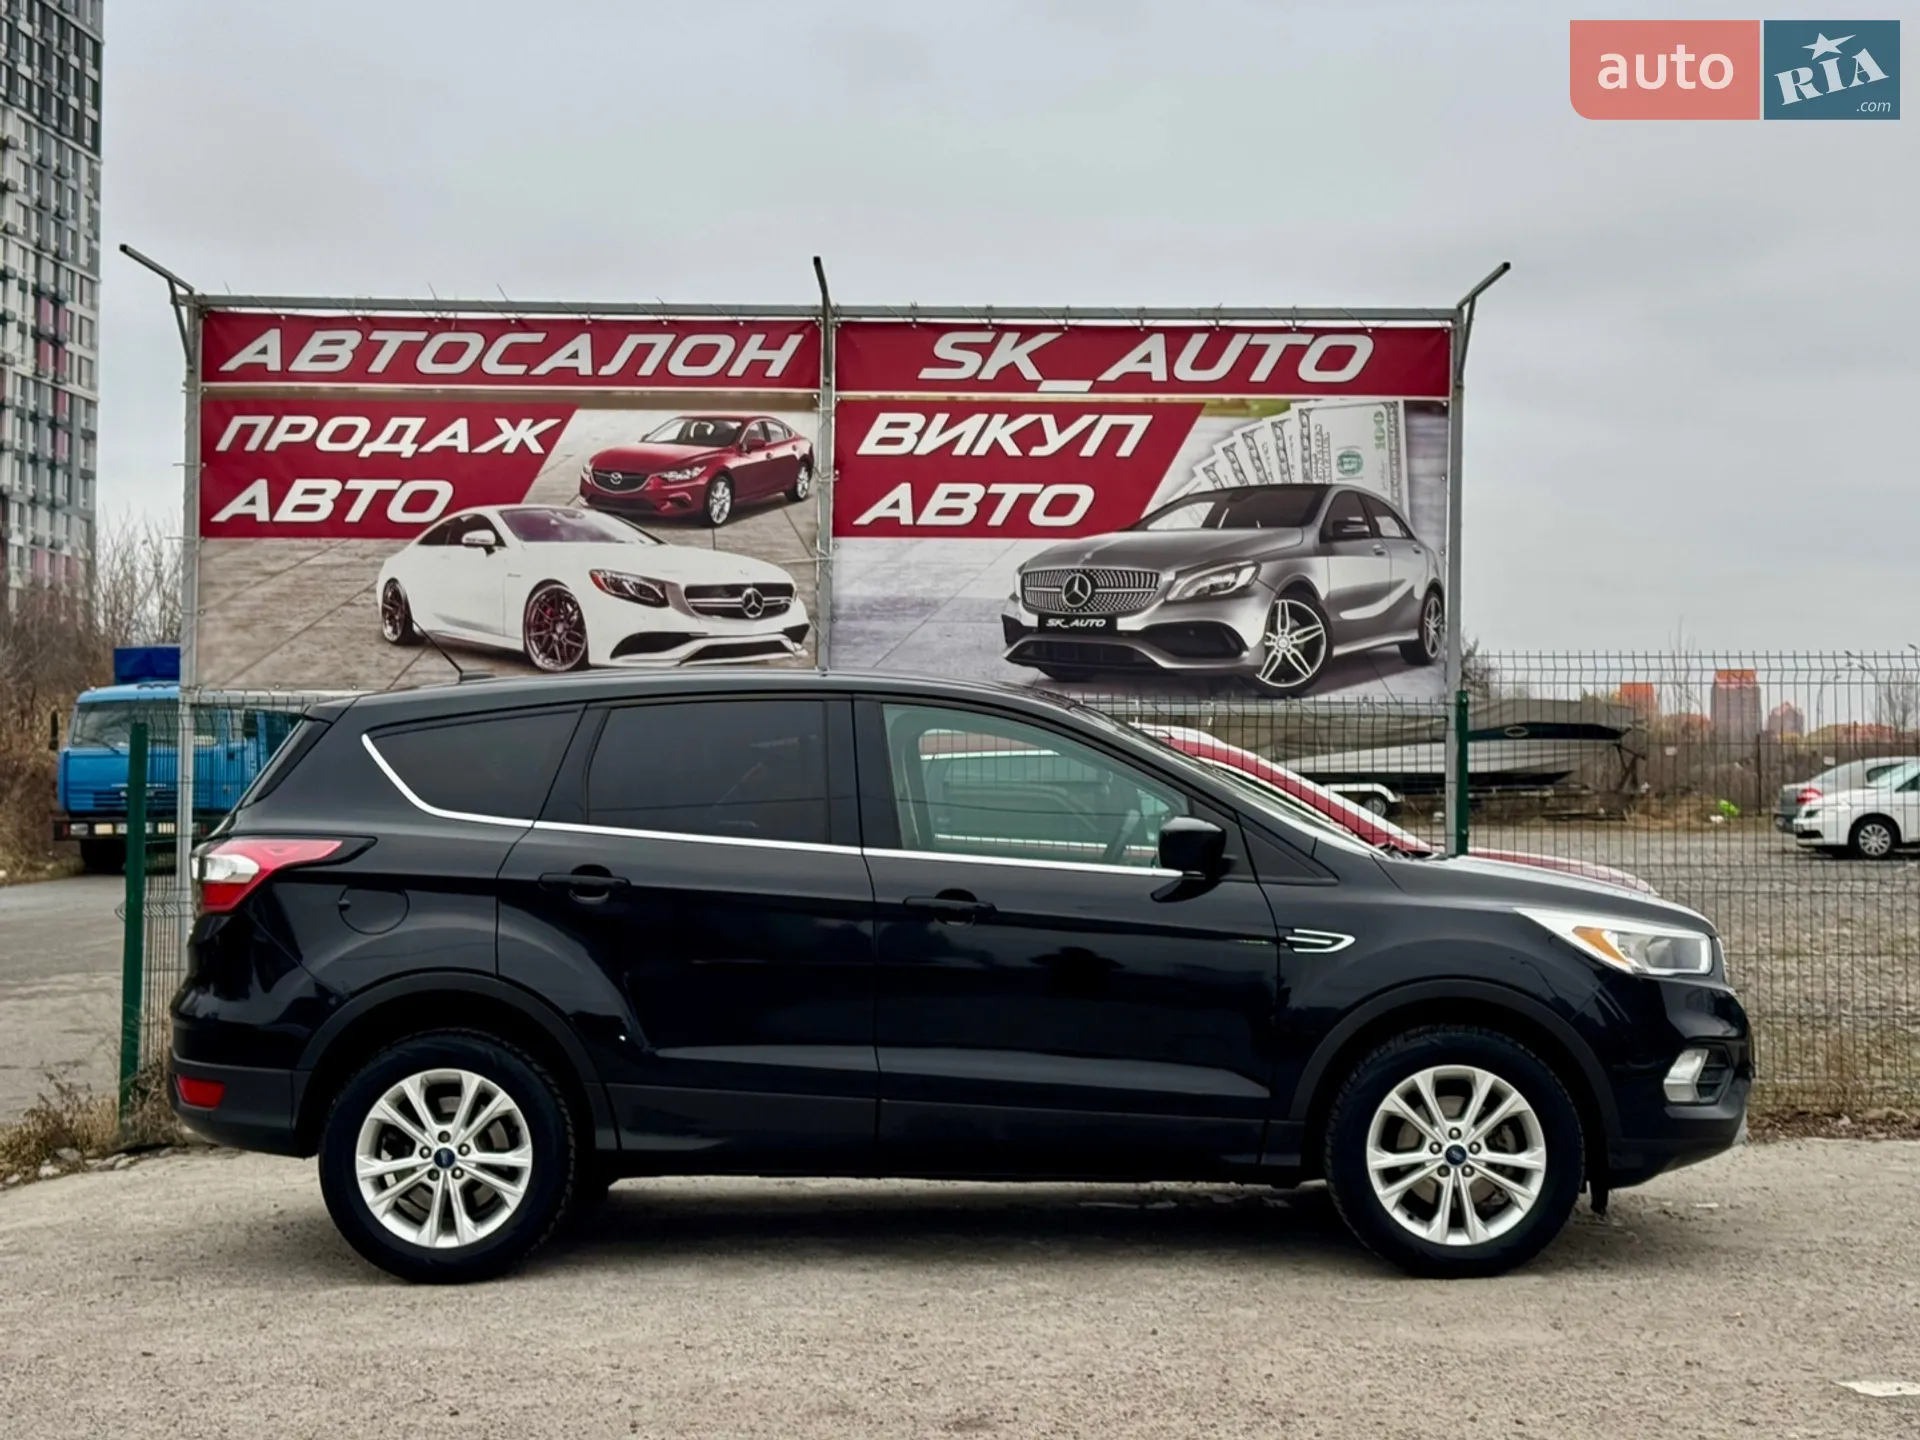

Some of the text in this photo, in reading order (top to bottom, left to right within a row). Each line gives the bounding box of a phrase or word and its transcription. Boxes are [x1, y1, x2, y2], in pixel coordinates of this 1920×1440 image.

[219, 329, 804, 377] АВТОСАЛОН
[917, 331, 1374, 392] SK_AUTO
[215, 415, 562, 458] ПРОДАЖ
[856, 412, 1153, 457] ВИКУП
[211, 479, 454, 523] АВТО
[853, 482, 1095, 527] АВТО
[1046, 618, 1107, 629] SK_AUTO
